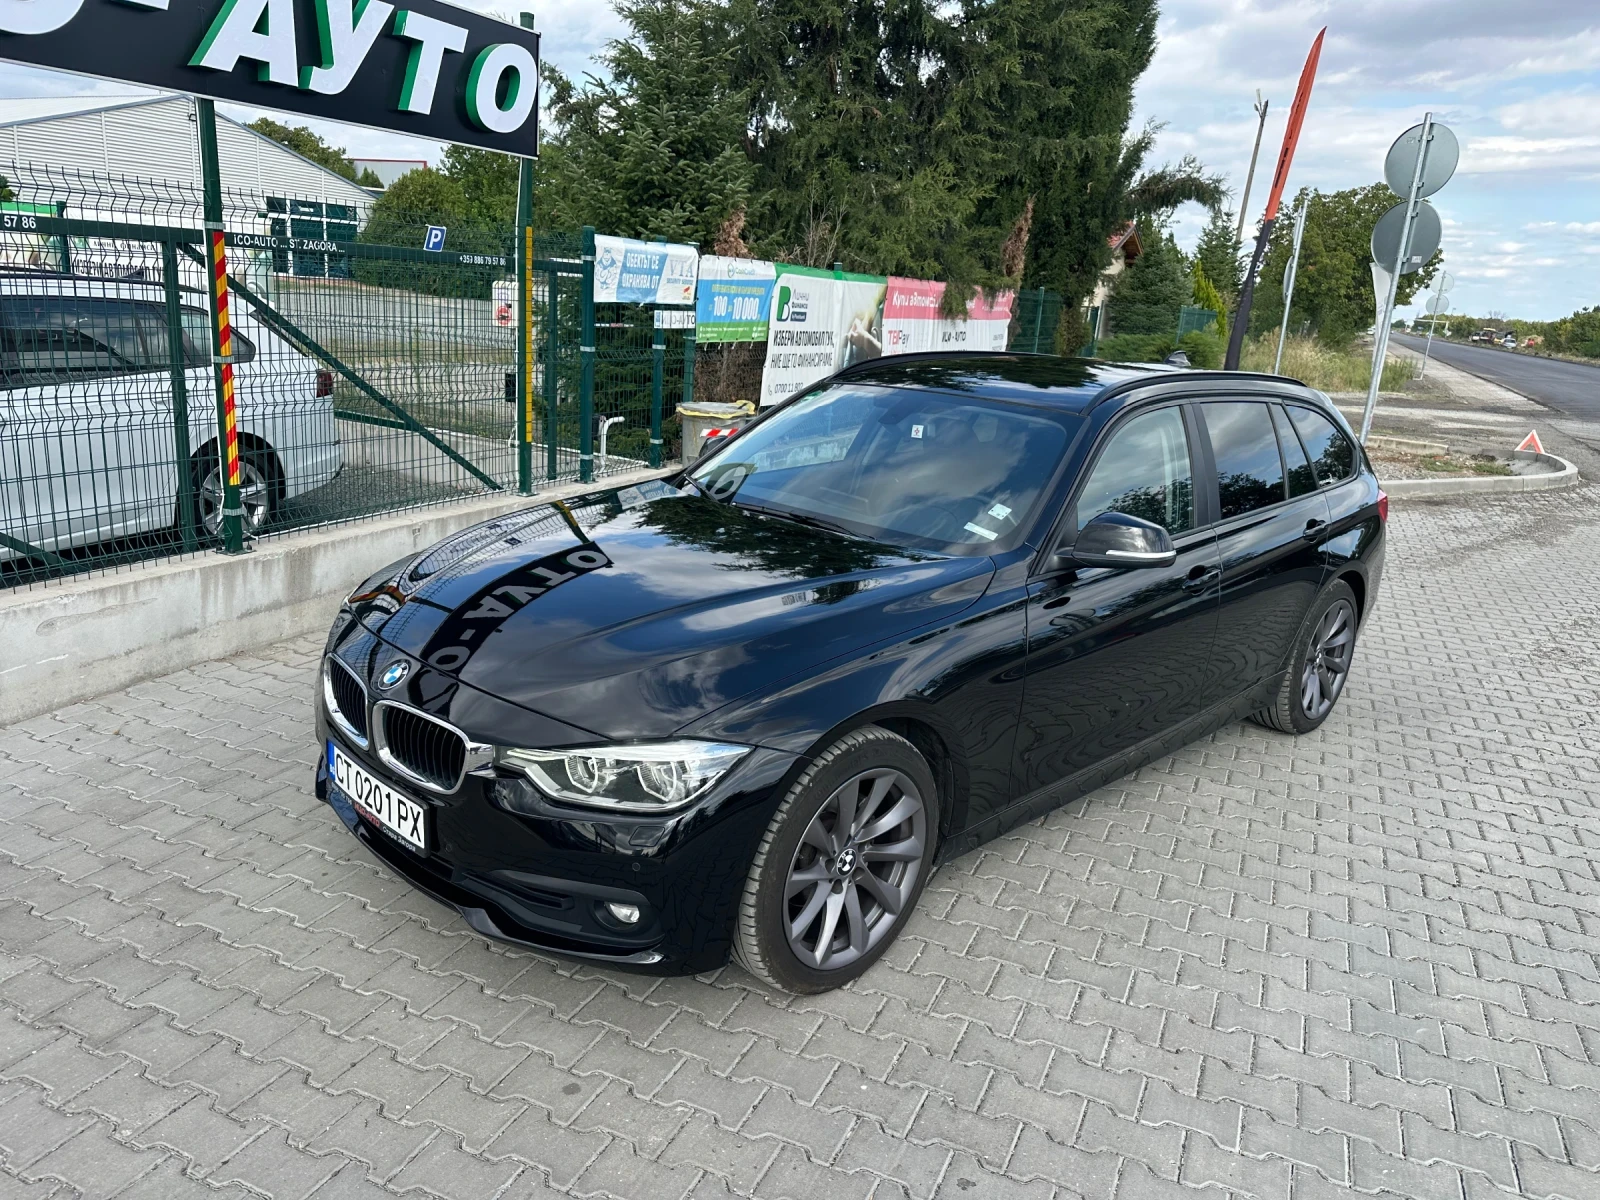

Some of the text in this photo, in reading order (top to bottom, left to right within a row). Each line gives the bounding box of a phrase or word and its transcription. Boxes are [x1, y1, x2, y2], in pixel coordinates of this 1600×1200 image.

[4, 215, 36, 229] 57 86
[303, 240, 337, 252] ZAGORA
[428, 229, 442, 249] P
[485, 256, 492, 265] 79
[627, 253, 660, 270] ОБЕКТЪТ СЕ
[621, 273, 660, 289] ОХРАНЯВА ОТ
[713, 295, 728, 317] 100
[892, 290, 909, 309] Купи
[773, 329, 795, 346] ИЗБЕРИ
[794, 330, 825, 347] АВТОМОБИЛ
[770, 352, 833, 371] НИЕ ЩЕ ГО ФИНАНСИРАМЕ
[787, 383, 794, 393] 11
[355, 769, 392, 823] 0201
[382, 826, 398, 842] Стара
[397, 835, 416, 853] Загора
